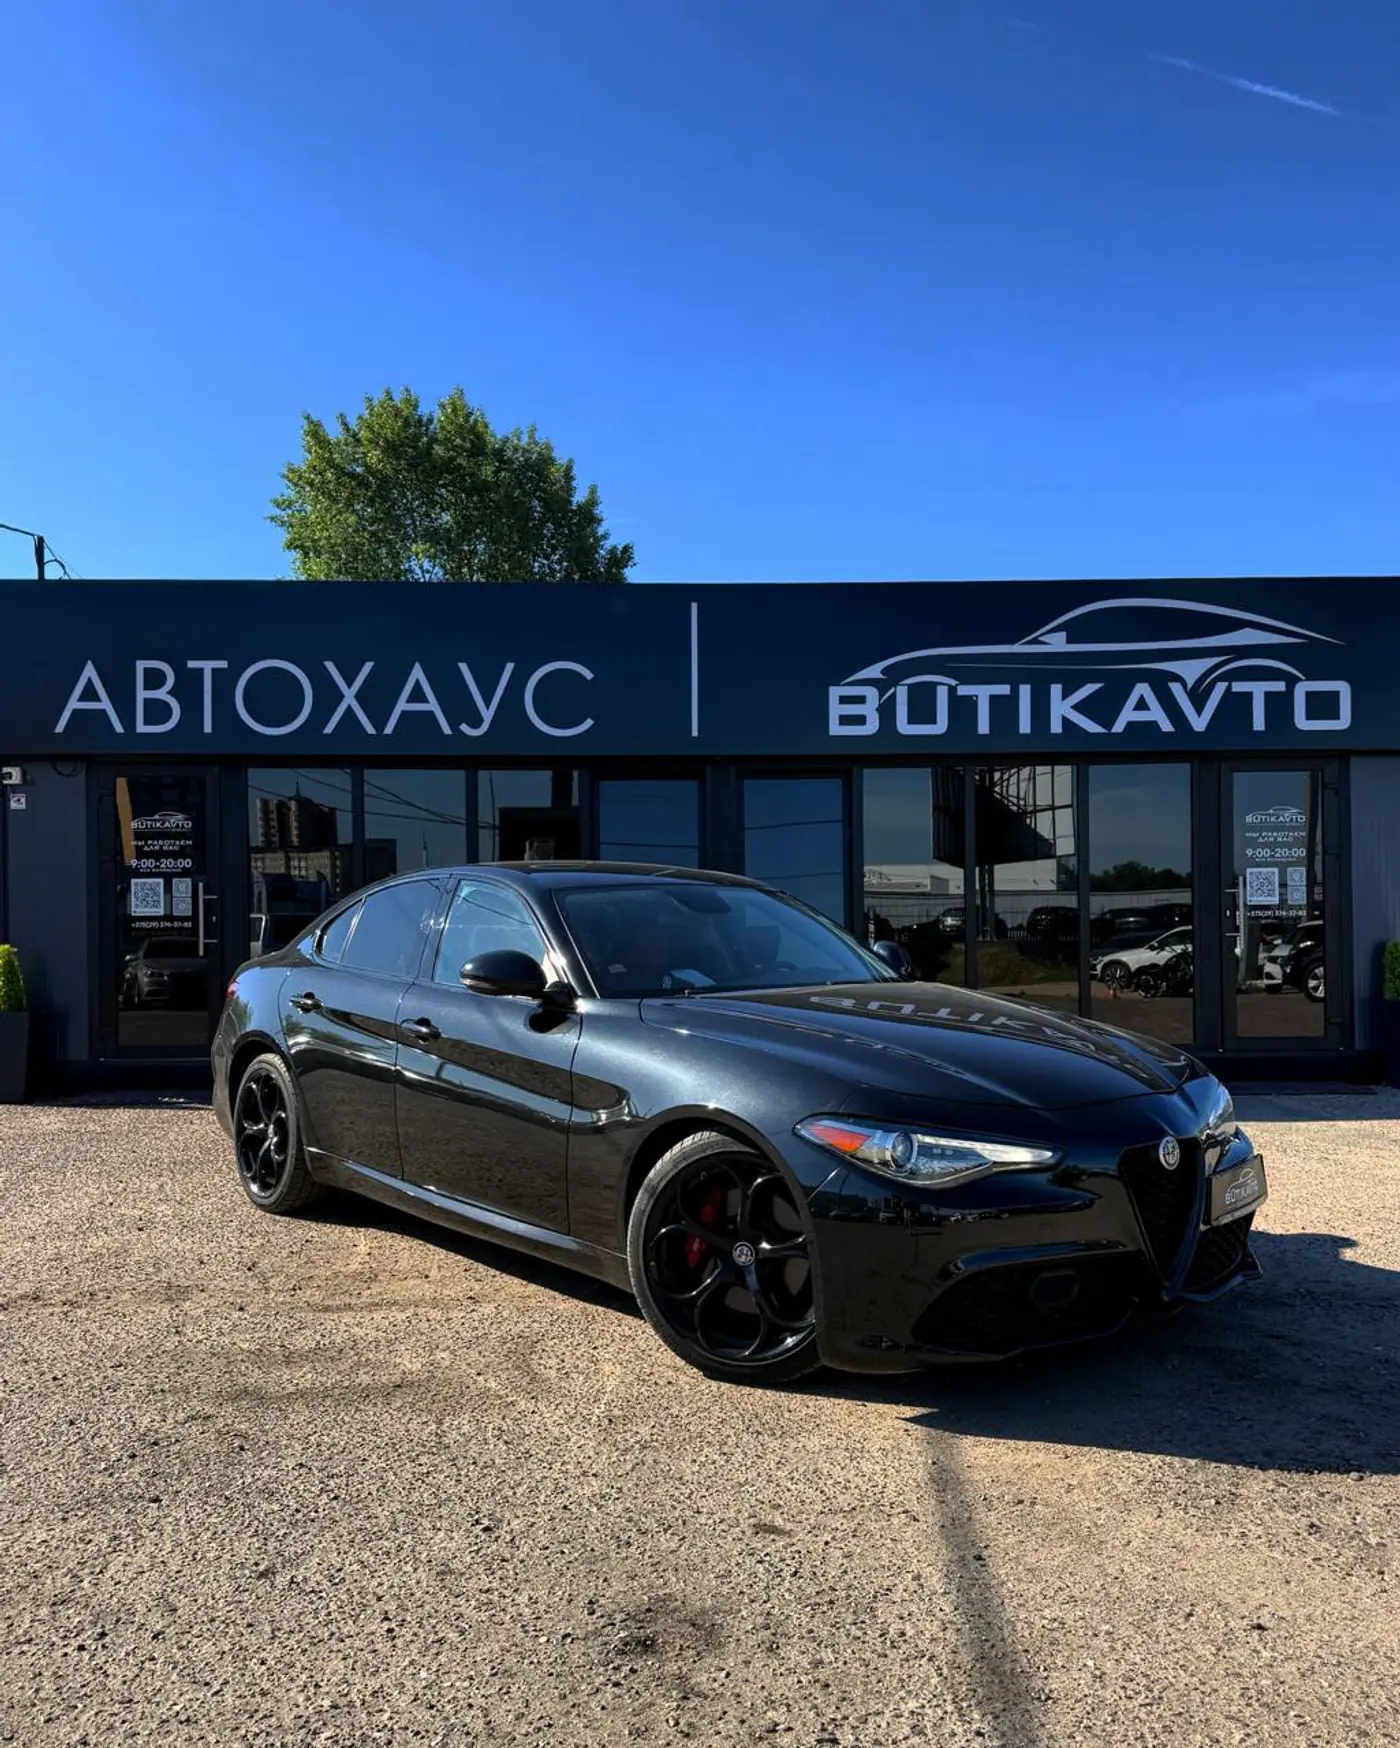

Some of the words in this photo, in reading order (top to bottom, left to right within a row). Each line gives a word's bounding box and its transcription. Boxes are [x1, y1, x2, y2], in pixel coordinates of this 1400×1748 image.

[53, 659, 596, 737] АВТОХАУС
[827, 679, 1352, 737] BUTIKAVTO
[1245, 815, 1306, 823] BUTIKAVTO
[131, 820, 192, 829] BUTIKAVTO
[1245, 847, 1306, 857] 9:00-20:00
[131, 859, 193, 869] 9:00-20:00
